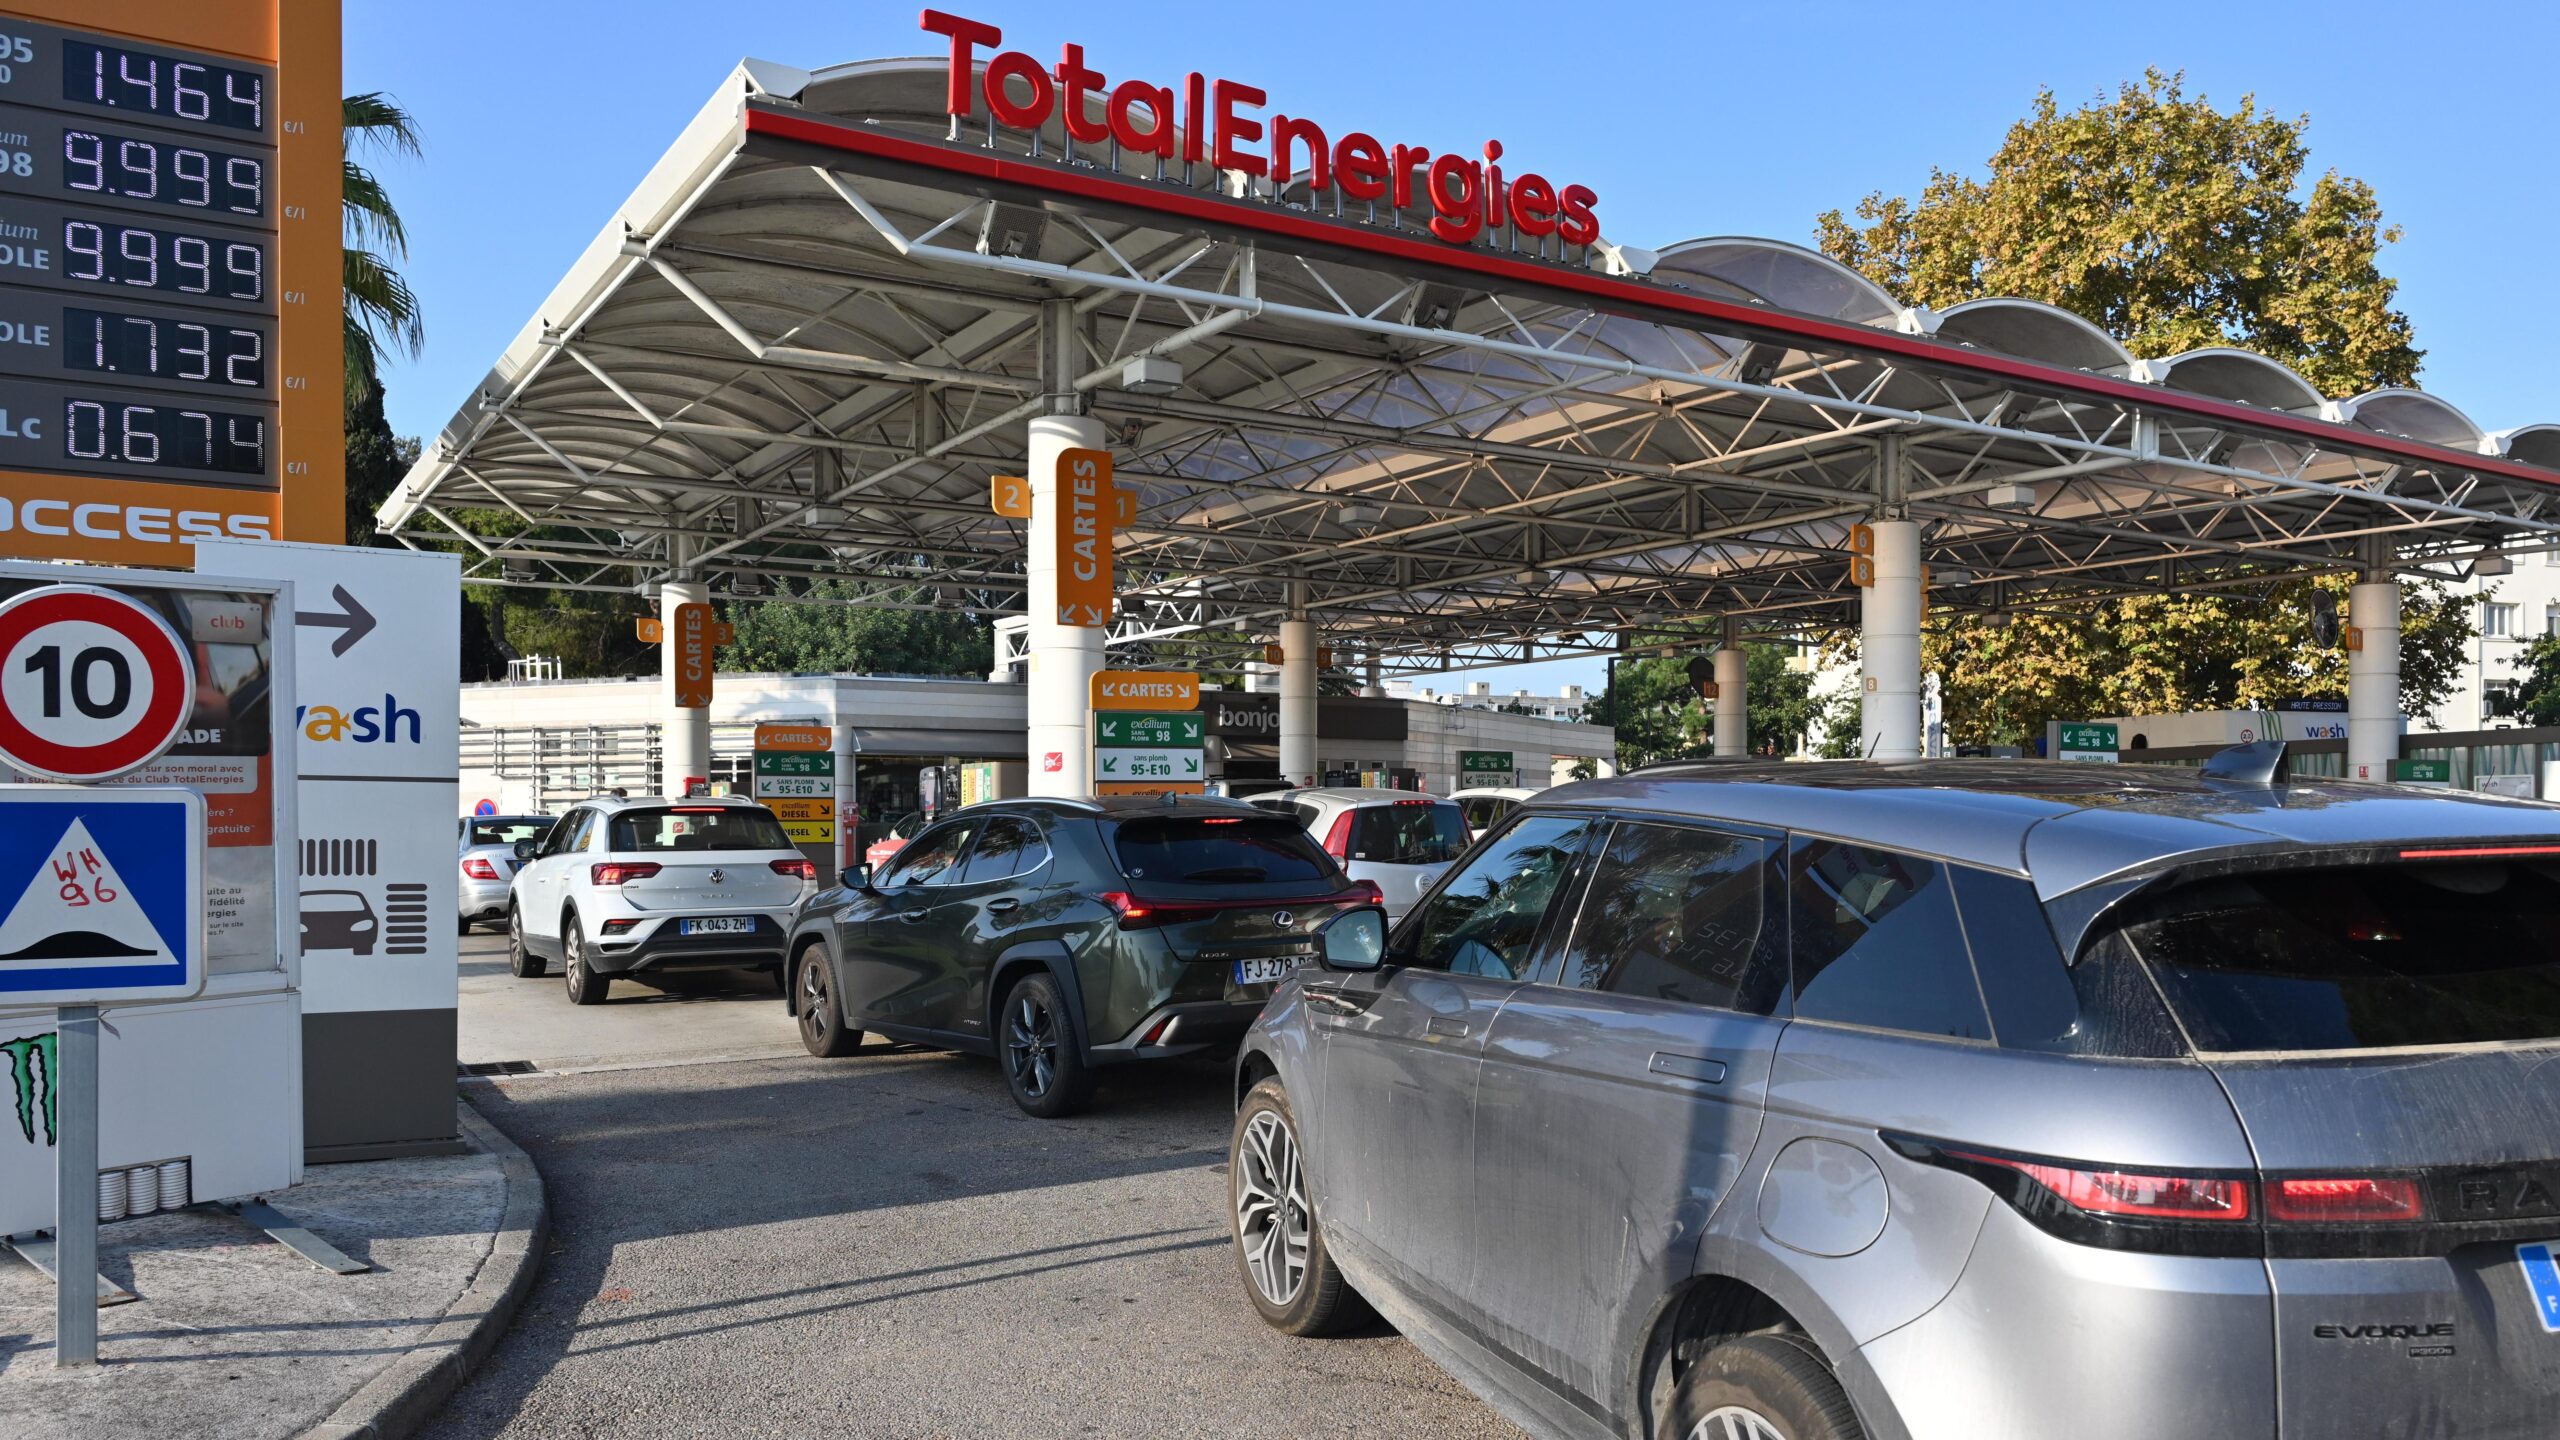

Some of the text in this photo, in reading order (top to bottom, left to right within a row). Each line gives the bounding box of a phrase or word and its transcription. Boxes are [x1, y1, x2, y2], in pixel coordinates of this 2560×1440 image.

[95, 50, 261, 127] 1.464
[919, 9, 1600, 245] TotalEnergies
[65, 131, 261, 215] 9.999
[65, 222, 261, 300] 9.999
[95, 317, 261, 386] 1.732
[67, 401, 263, 468] 0.674
[1004, 485, 1020, 509] 2
[1116, 497, 1126, 518] 1
[1073, 458, 1097, 581] CARTES
[1858, 531, 1867, 548] 6
[1858, 563, 1868, 580] 8
[210, 615, 245, 629] club
[645, 624, 655, 637] 4
[686, 608, 702, 681] CARTES
[25, 645, 131, 718] 10
[1120, 683, 1173, 697] CARTES
[2291, 701, 2310, 710] HAUTE
[1131, 718, 1170, 729] excellium
[2305, 722, 2345, 738] wash
[774, 733, 814, 743] CARTES
[1156, 730, 1170, 742] 98
[1148, 754, 1168, 764] plomb
[165, 765, 184, 773] son
[187, 764, 217, 773] moral
[219, 765, 244, 773] avec
[799, 764, 810, 772] 98
[1131, 764, 1171, 775] 95-E10
[128, 775, 142, 784] du
[145, 775, 170, 784] Club
[174, 775, 244, 786] TotalEnergies
[779, 785, 813, 794] 95-E10
[2314, 1323, 2455, 1339] EVOQUE
